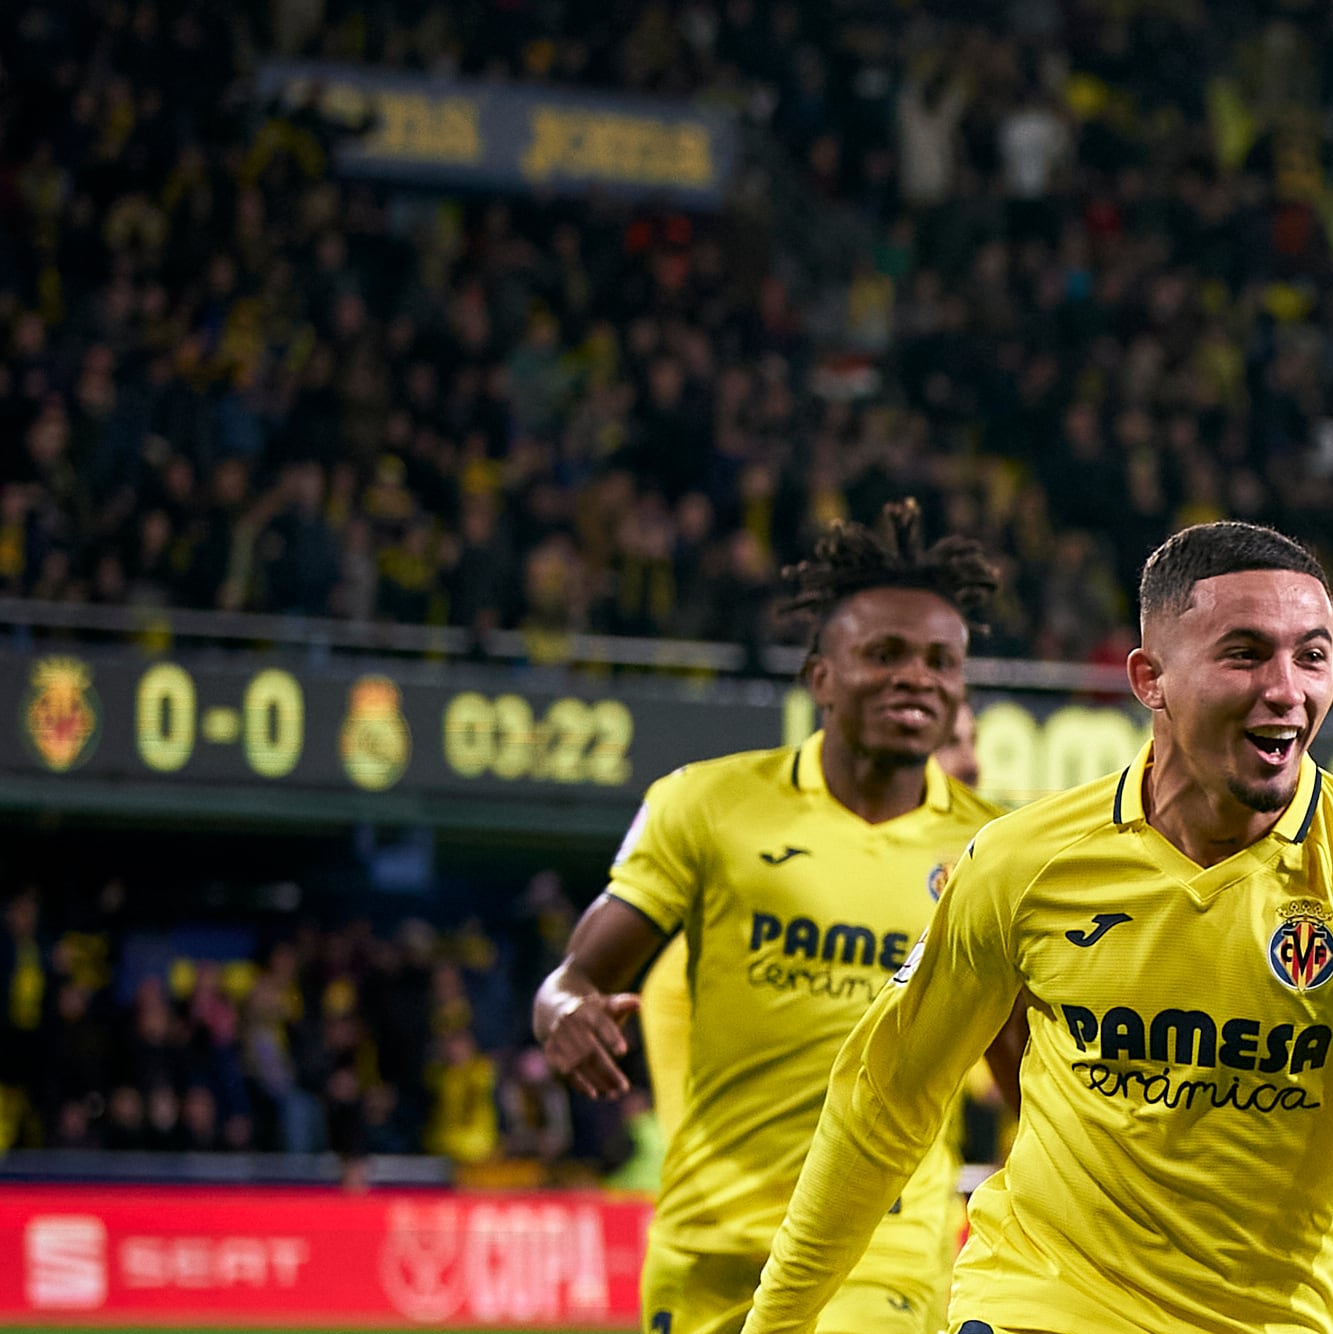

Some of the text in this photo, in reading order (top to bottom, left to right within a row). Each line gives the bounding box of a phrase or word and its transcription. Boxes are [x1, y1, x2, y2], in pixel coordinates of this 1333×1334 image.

[135, 661, 304, 779] 0-0
[749, 910, 910, 974] PAME
[1060, 1003, 1333, 1076] PAMESA
[118, 1236, 310, 1290] SEAT
